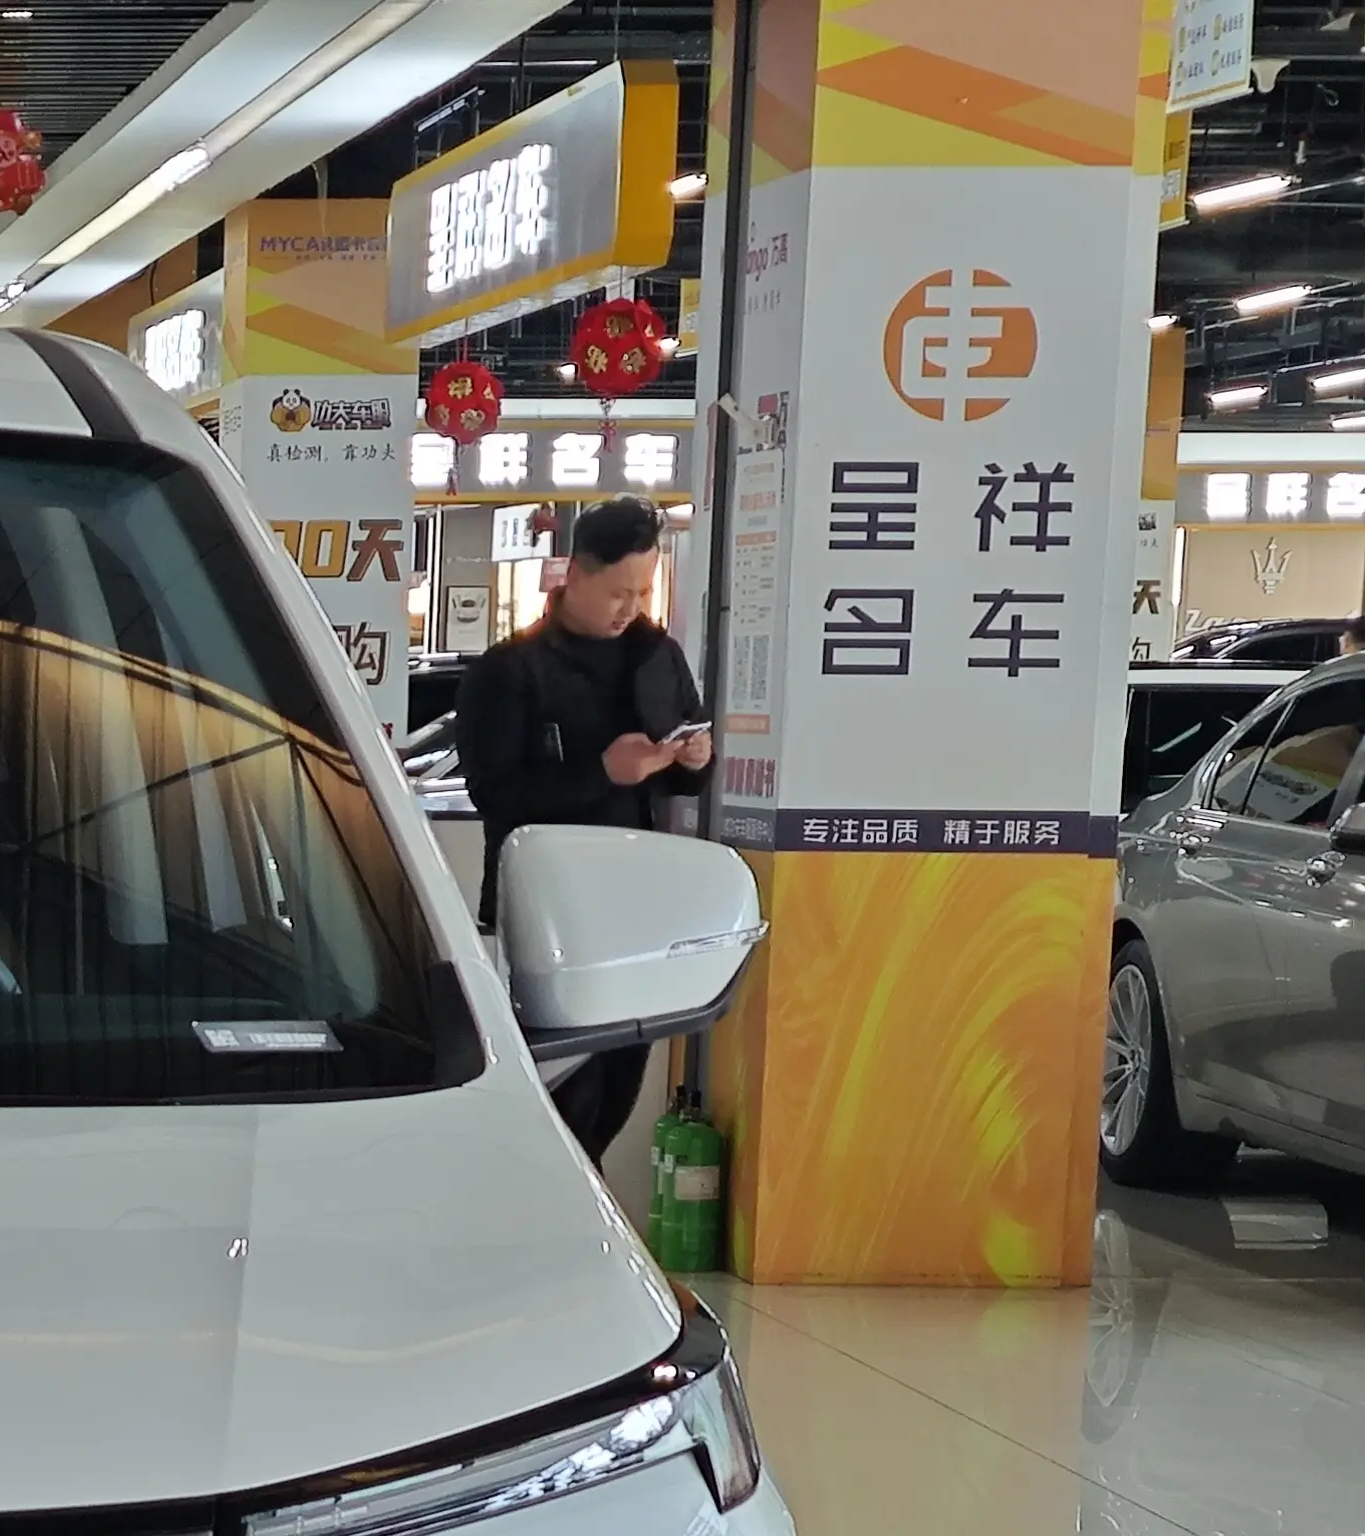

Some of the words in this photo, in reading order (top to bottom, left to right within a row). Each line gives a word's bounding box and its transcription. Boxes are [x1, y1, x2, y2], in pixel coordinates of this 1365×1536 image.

[828, 461, 1075, 553] 呈祥
[821, 588, 1066, 678] 名车
[801, 818, 919, 844] 专注品质
[943, 818, 1062, 845] 精于服务
